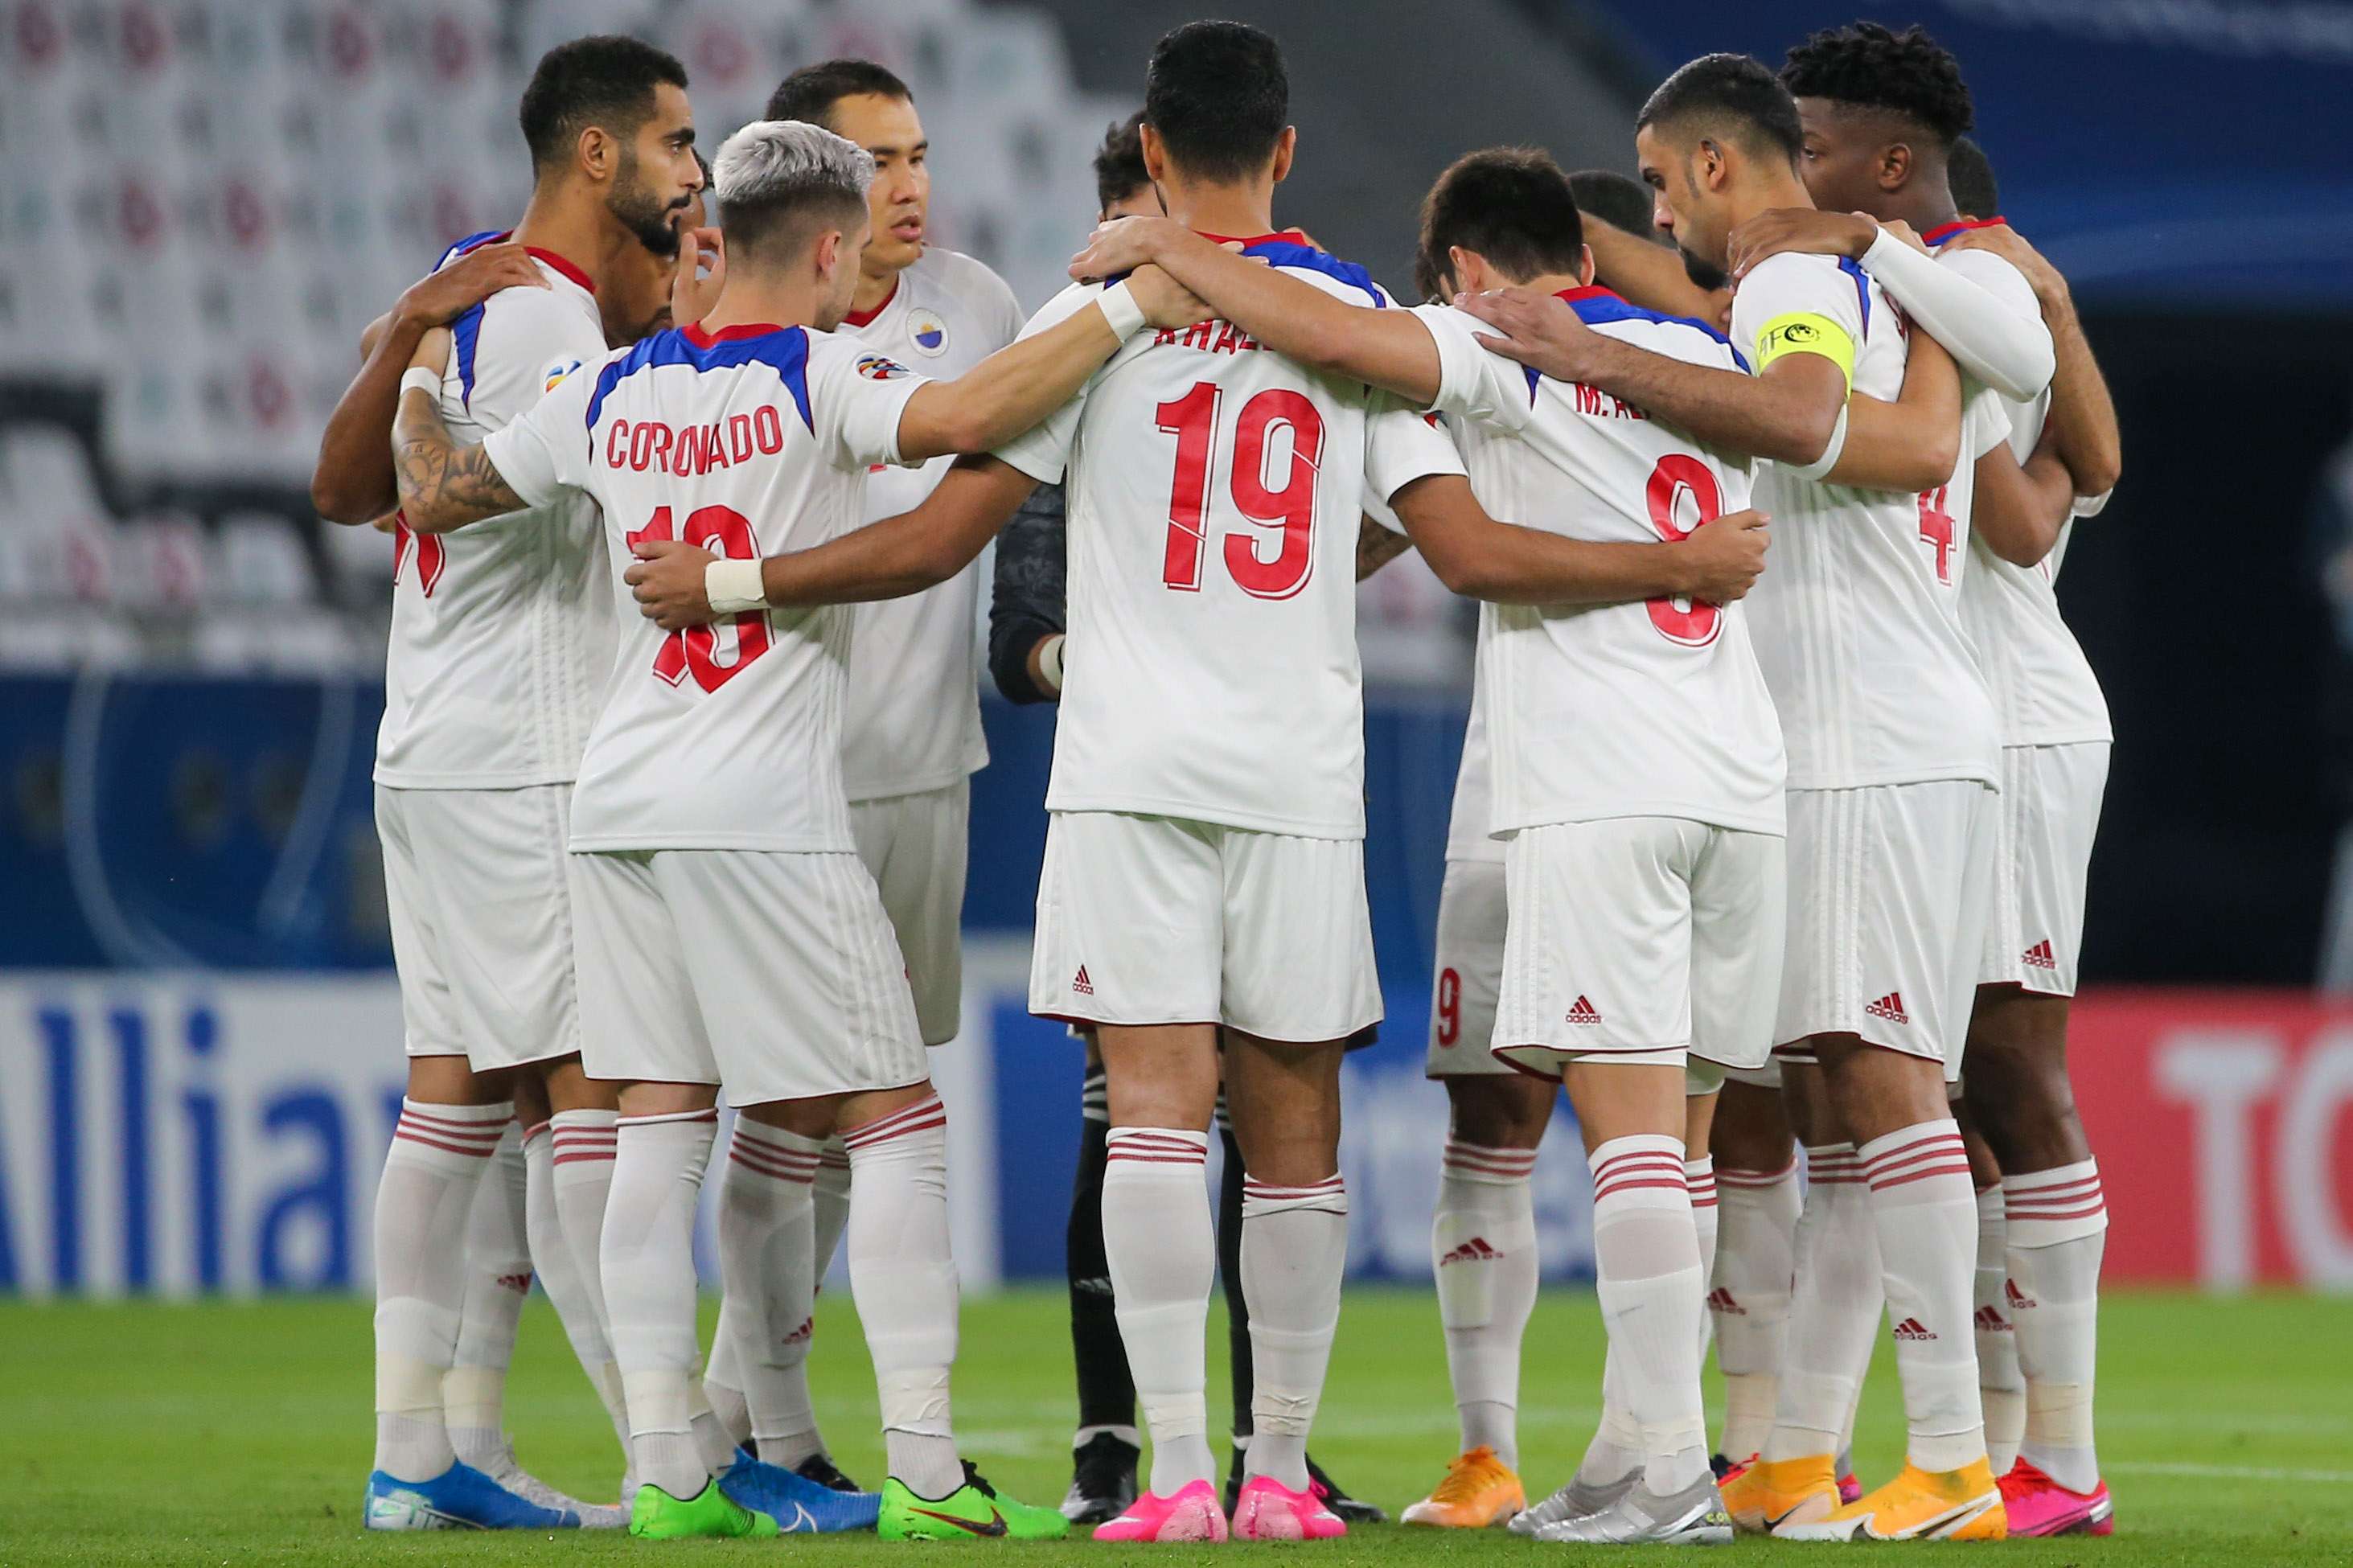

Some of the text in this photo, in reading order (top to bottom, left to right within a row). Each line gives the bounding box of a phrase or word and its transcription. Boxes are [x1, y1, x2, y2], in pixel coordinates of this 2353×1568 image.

[607, 404, 783, 478] CORONADO
[1156, 381, 1326, 601] 19
[1646, 454, 1725, 647] 8
[1918, 484, 1957, 587] 4
[626, 504, 776, 695] 10
[1438, 967, 1460, 1049] 9
[1565, 1014, 1602, 1024] adidas
[1866, 1005, 1908, 1024] adidas
[0, 1004, 406, 1299] llia
